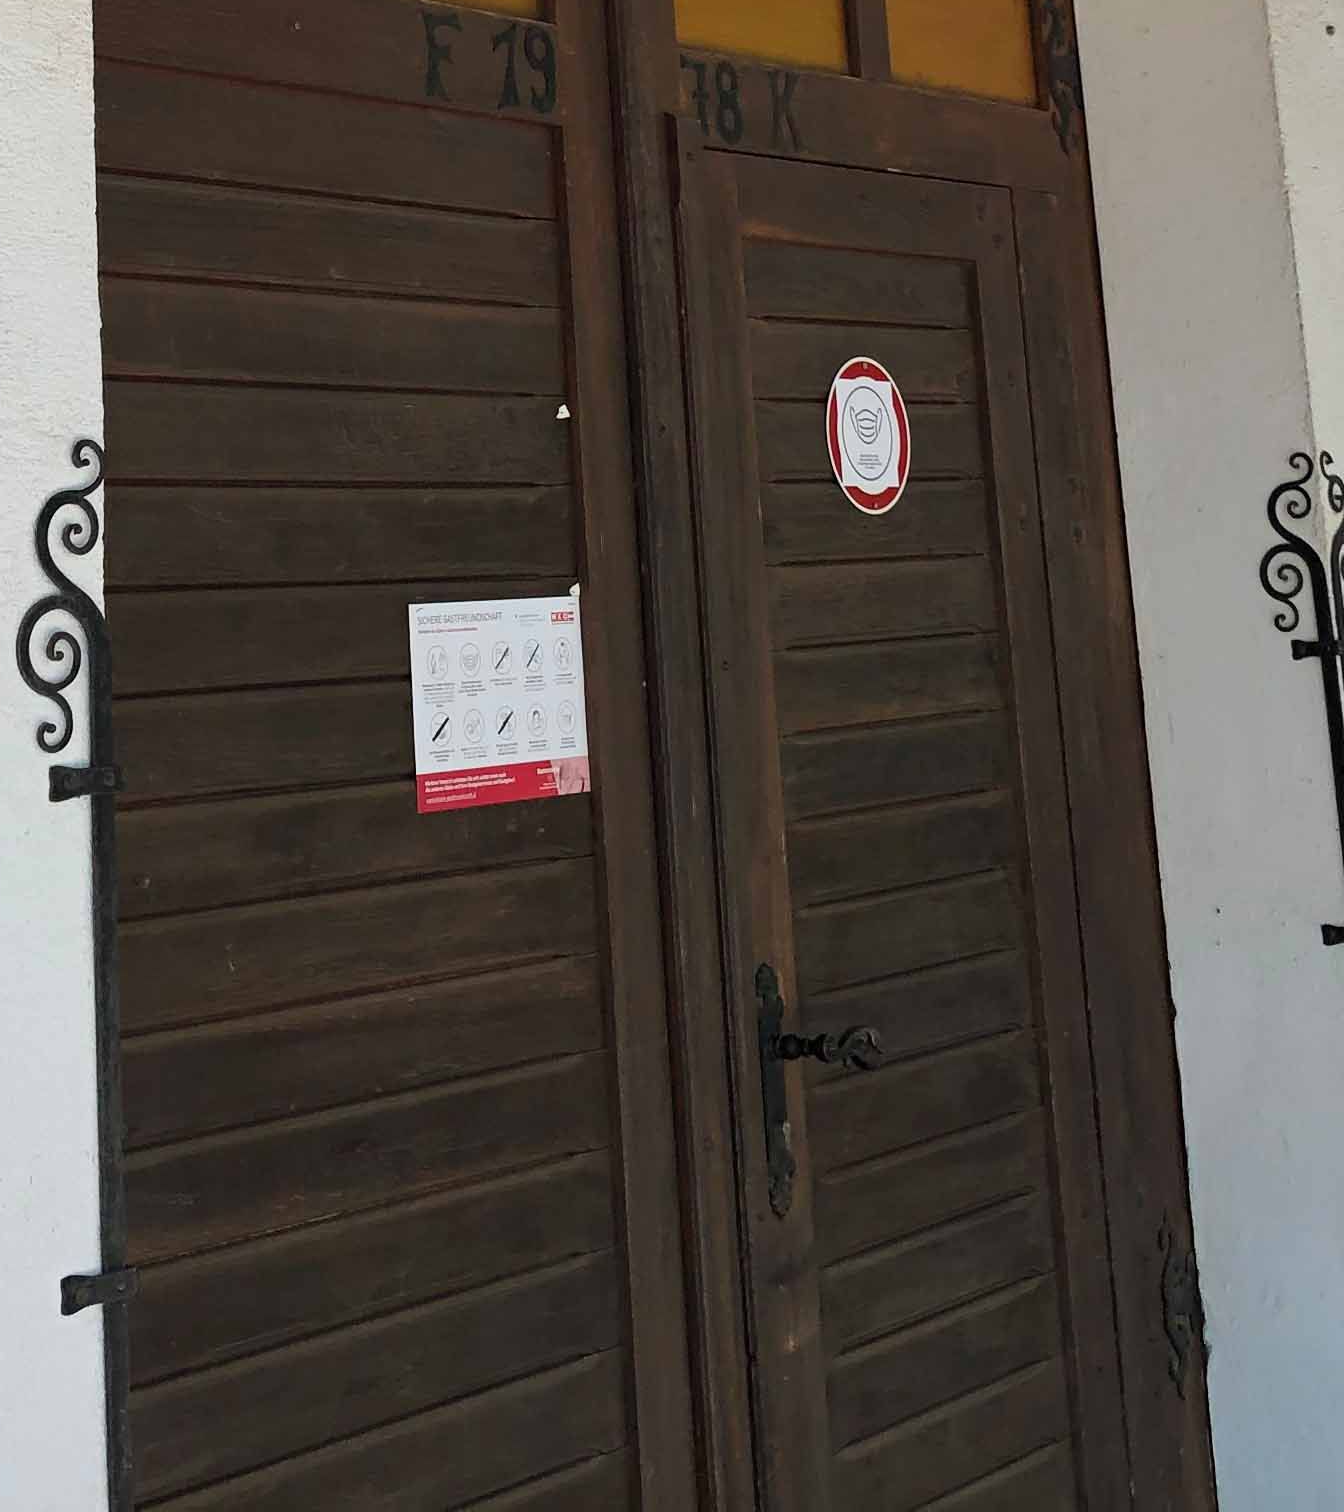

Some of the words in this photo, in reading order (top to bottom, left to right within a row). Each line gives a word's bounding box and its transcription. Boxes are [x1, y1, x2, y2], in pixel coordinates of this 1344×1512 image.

[420, 8, 462, 102] F
[492, 22, 557, 114] 19
[767, 69, 804, 153] K
